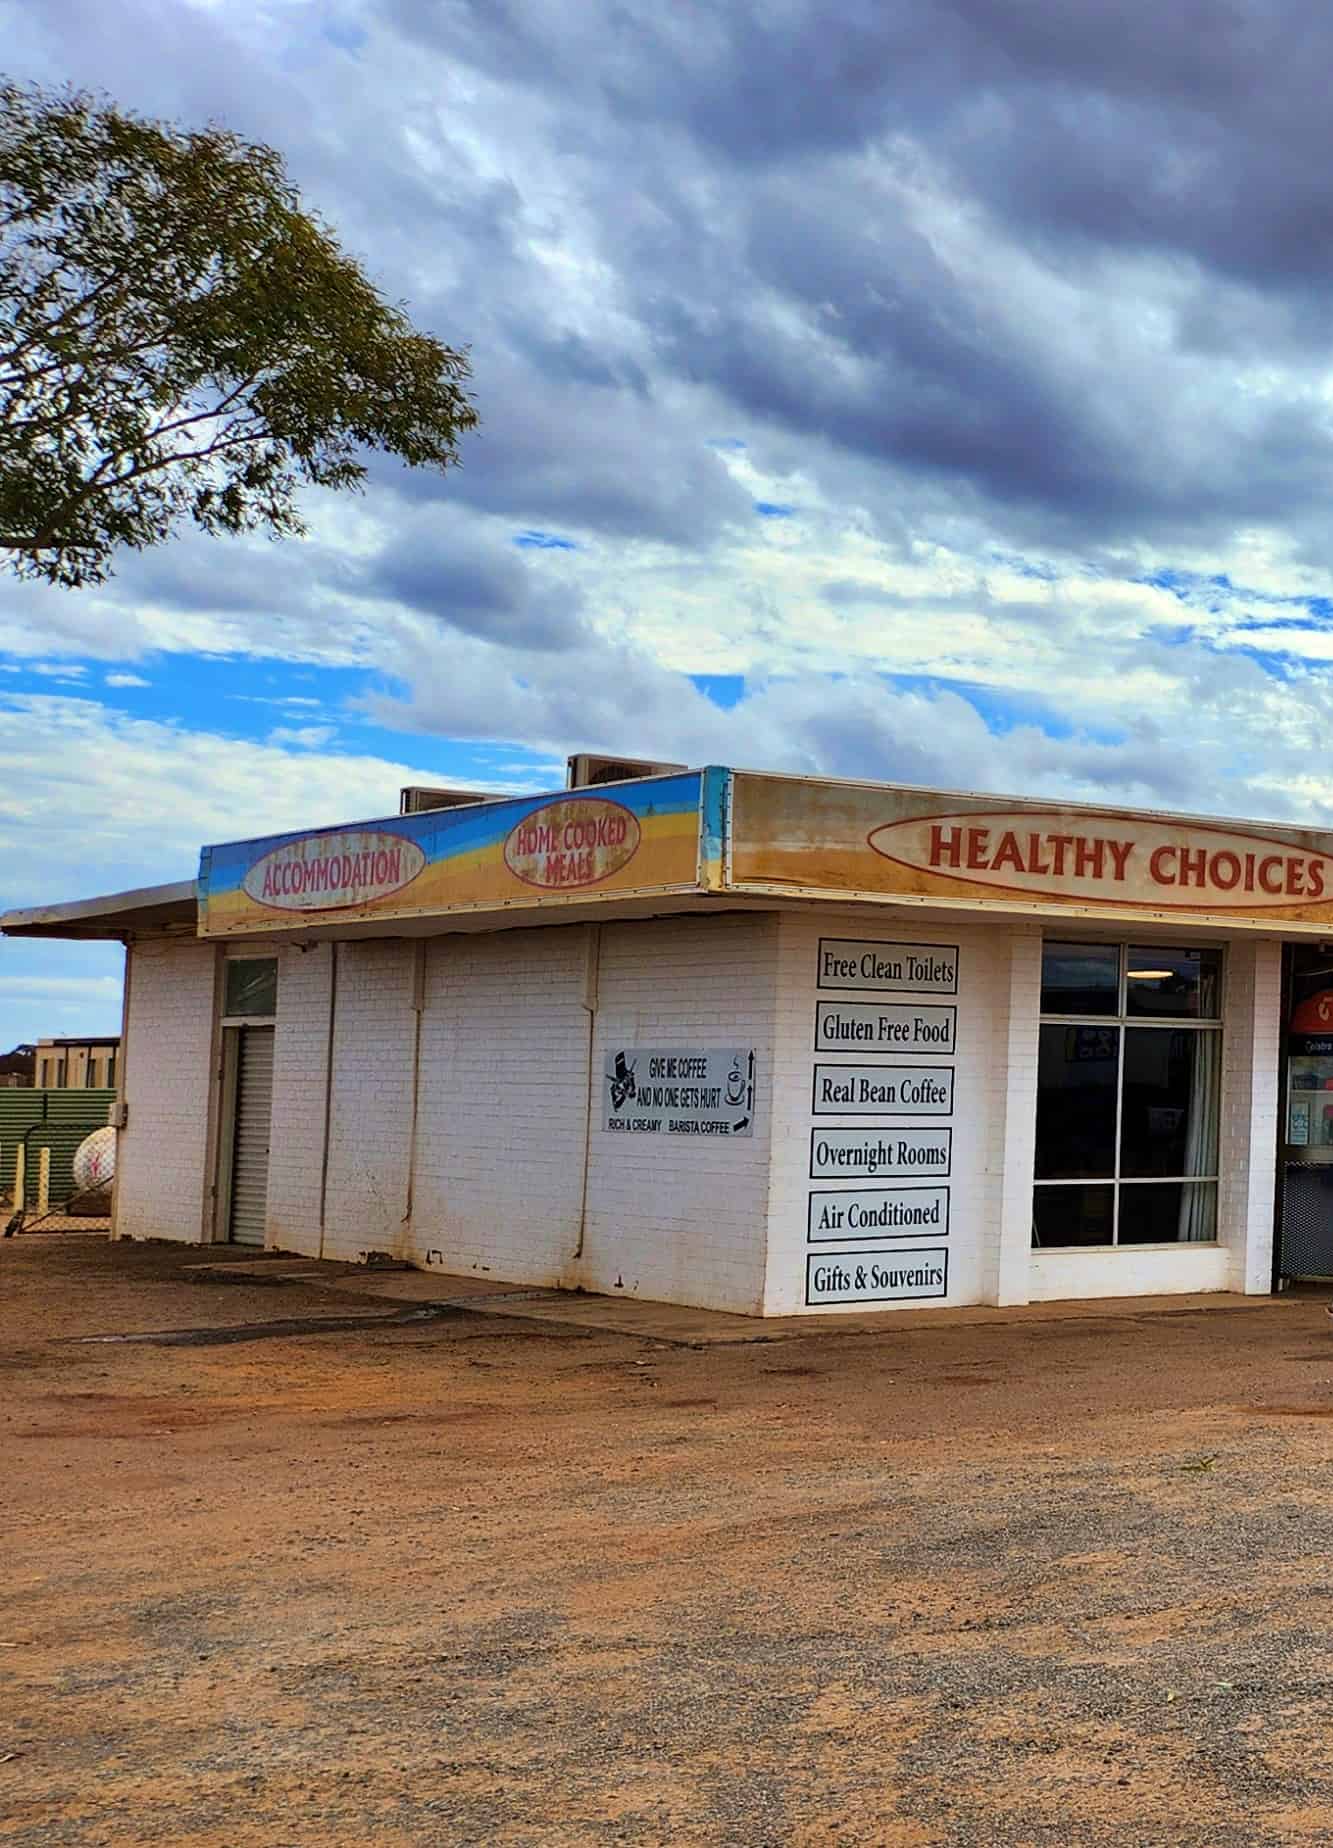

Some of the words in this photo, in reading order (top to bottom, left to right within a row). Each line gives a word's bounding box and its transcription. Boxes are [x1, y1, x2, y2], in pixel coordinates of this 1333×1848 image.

[517, 827, 559, 856] HOME
[563, 816, 626, 849] COOKED
[263, 847, 402, 898] ACCOMMODATION
[545, 851, 595, 883] MEALS
[928, 825, 1136, 882] HEALTHY
[1149, 845, 1326, 897] CHOICES
[823, 952, 857, 978] Free
[860, 953, 903, 980] Clean
[906, 956, 954, 983] Toilets
[823, 1014, 874, 1041] Gluten
[878, 1016, 910, 1041] Free
[913, 1018, 950, 1042] Food
[649, 1058, 666, 1079] GIVE
[667, 1058, 677, 1079] ME
[678, 1058, 707, 1079] COFFEE
[636, 1087, 651, 1107] AND
[653, 1087, 664, 1108] NO
[664, 1087, 679, 1108] ONE
[680, 1087, 699, 1109] GETS
[700, 1087, 722, 1109] HURT
[821, 1077, 855, 1103] Real
[859, 1078, 896, 1104] Bean
[900, 1078, 947, 1104] Coffee
[608, 1118, 625, 1131] RICH
[632, 1119, 663, 1132] CREAMY
[668, 1119, 700, 1133] BARISTA
[700, 1121, 731, 1135] COFFEE
[816, 1140, 893, 1174] Overnight
[897, 1141, 947, 1166] Rooms
[818, 1204, 845, 1230] Air
[847, 1199, 940, 1228] Conditioned
[814, 1265, 851, 1292] Gifts
[854, 1265, 868, 1290] &
[871, 1262, 943, 1289] Souvenirs
